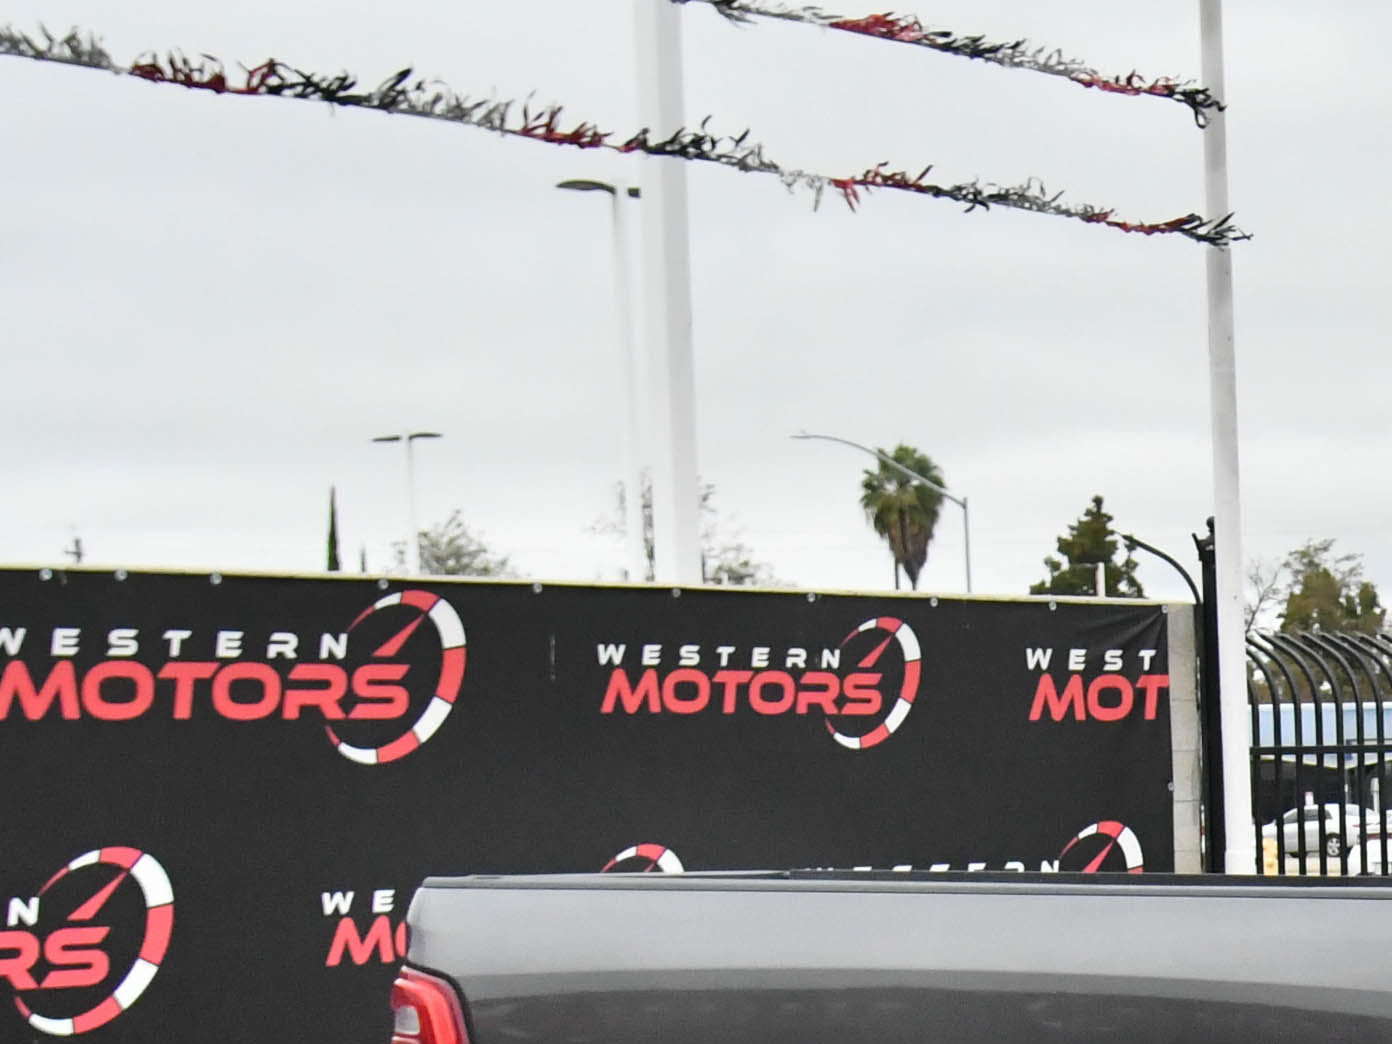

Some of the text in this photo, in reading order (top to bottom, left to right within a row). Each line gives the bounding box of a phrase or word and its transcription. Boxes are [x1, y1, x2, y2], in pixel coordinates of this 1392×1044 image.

[0, 627, 348, 660] WESTERN
[597, 643, 841, 669] WESTERN
[1025, 647, 1157, 671] WEST
[0, 660, 411, 721] MOTORS
[600, 668, 883, 716] MOTORS
[1028, 673, 1170, 722] MOT
